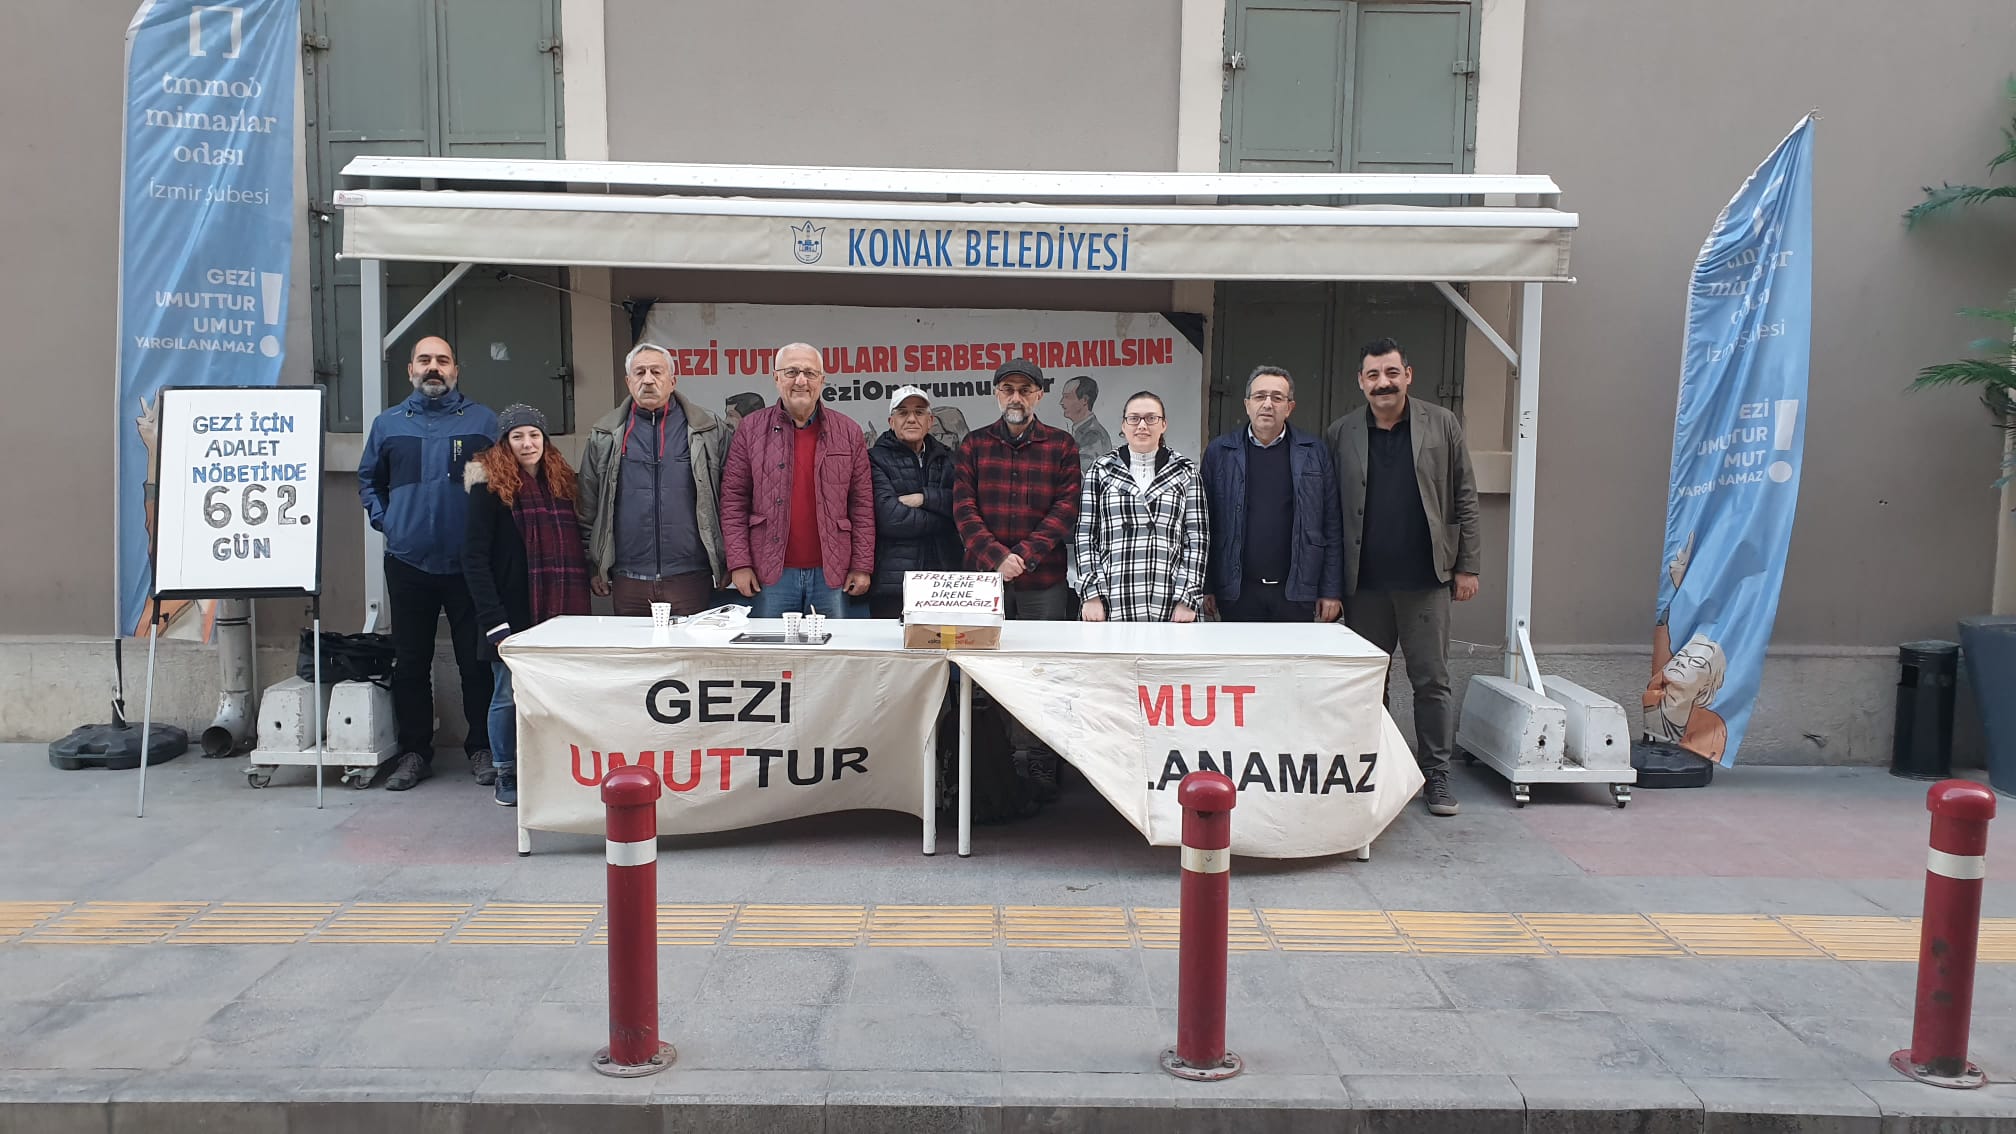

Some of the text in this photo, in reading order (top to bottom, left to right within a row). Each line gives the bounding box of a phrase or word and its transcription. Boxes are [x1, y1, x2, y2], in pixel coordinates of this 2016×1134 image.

[162, 72, 262, 98] tmmob
[849, 225, 1129, 271] KONAK BELEDİYESİ
[207, 267, 256, 287] GEZİ
[155, 291, 256, 312] UMUTTUR
[193, 317, 256, 336] UMUT
[135, 336, 255, 354] YARGILANAMAZ
[724, 345, 897, 376] TUTULARI
[904, 342, 1016, 373] SERBEST
[1022, 338, 1173, 369] BIRAKILSIN!
[192, 411, 294, 436] GEZİ İÇİN
[204, 439, 280, 457] ADALET
[192, 461, 308, 484] NÖBETİNDE
[203, 483, 311, 529] 662.
[212, 533, 272, 562] GÜN
[645, 670, 793, 725] GEZİ
[1147, 749, 1378, 794] ANAMAZ
